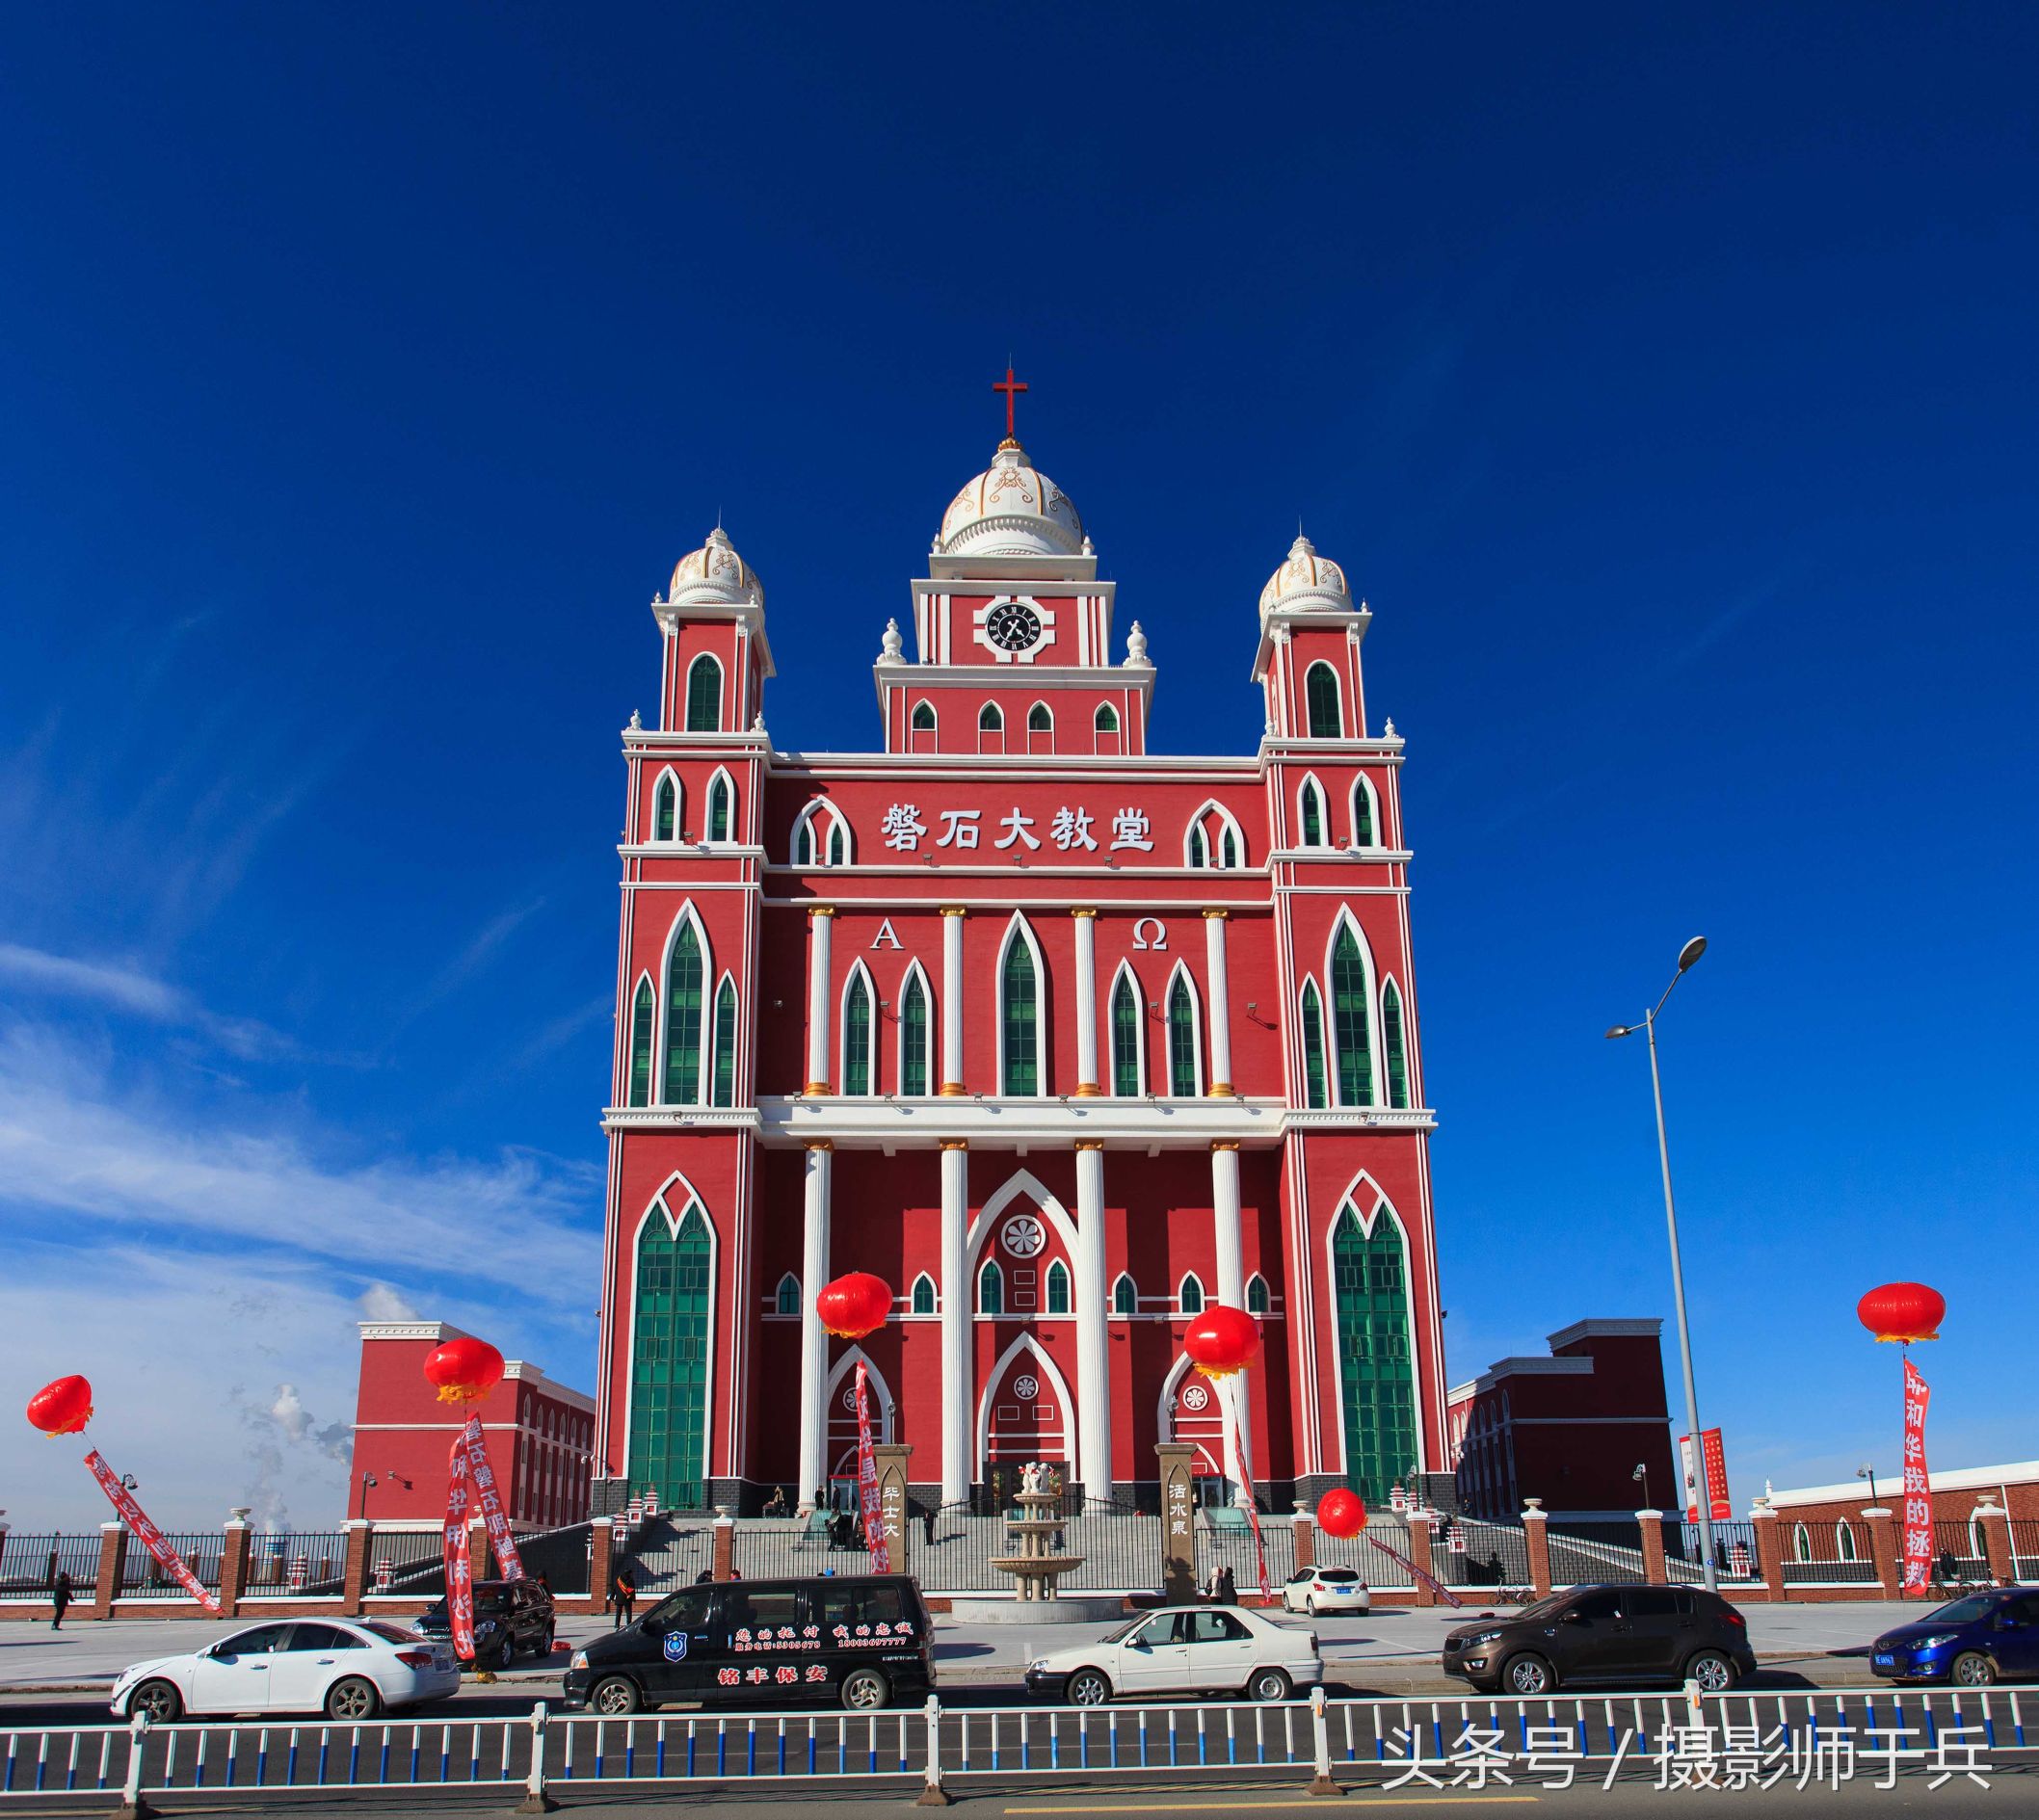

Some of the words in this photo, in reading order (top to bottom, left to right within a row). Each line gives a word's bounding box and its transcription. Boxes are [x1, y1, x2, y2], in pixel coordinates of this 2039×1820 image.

[881, 804, 1153, 851] 磐石大教堂
[1132, 918, 1167, 950] Ω
[883, 1487, 900, 1537] 毕士大
[1169, 1485, 1187, 1535] 活水泉
[735, 1625, 819, 1642] 您的托付
[833, 1622, 914, 1638] 我的忠诚
[718, 1665, 828, 1685] 铭丰保安
